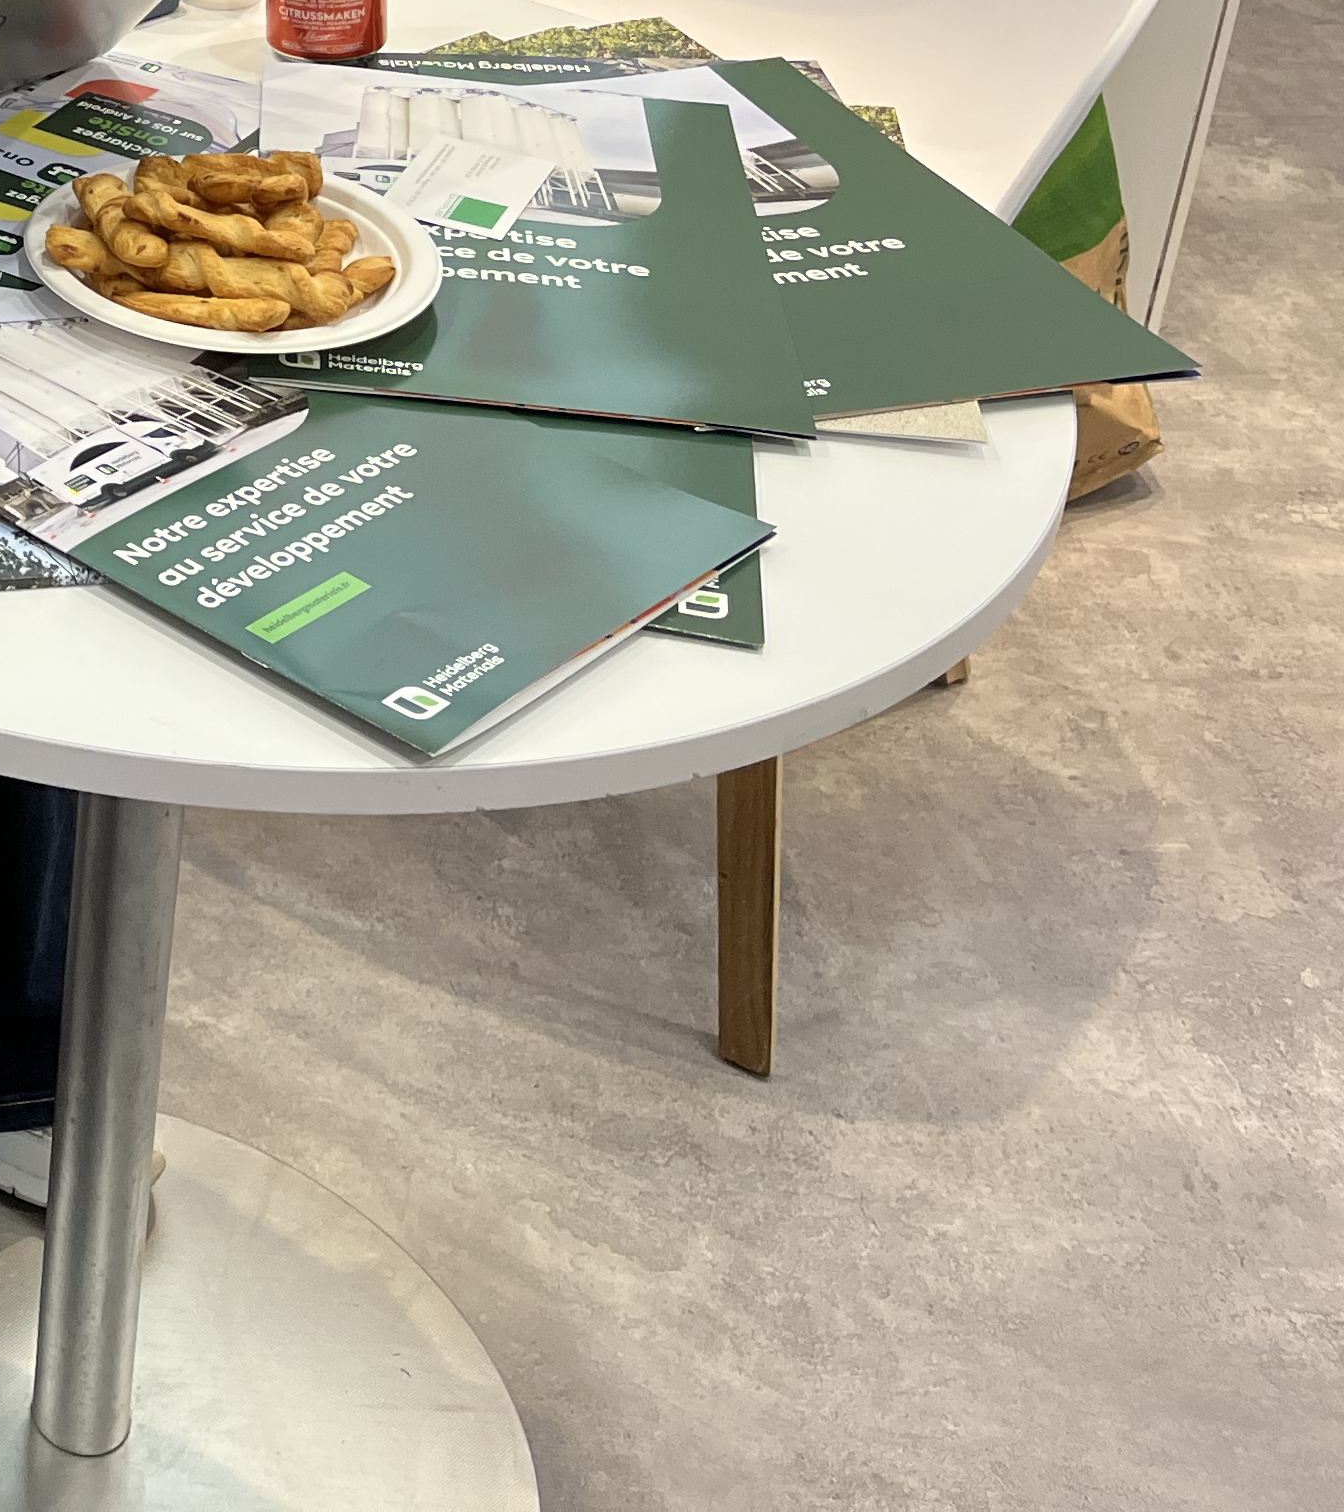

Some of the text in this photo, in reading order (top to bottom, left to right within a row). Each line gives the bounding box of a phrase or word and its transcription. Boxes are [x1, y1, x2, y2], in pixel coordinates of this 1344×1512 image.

[479, 59, 592, 75] Heidelberg
[76, 100, 135, 121] Android
[134, 117, 151, 127] et
[88, 115, 169, 147] OnSite
[152, 122, 179, 136] iOS
[806, 238, 906, 258] votre
[487, 247, 535, 265] de
[545, 254, 651, 279] votre
[326, 361, 413, 377] Materials
[328, 352, 425, 372] Heidelberg
[113, 445, 336, 566] Notre expertise
[157, 441, 418, 587] au service de votre
[196, 483, 416, 609] développement
[422, 641, 500, 689] Heidelberg
[438, 654, 505, 698] Materials
